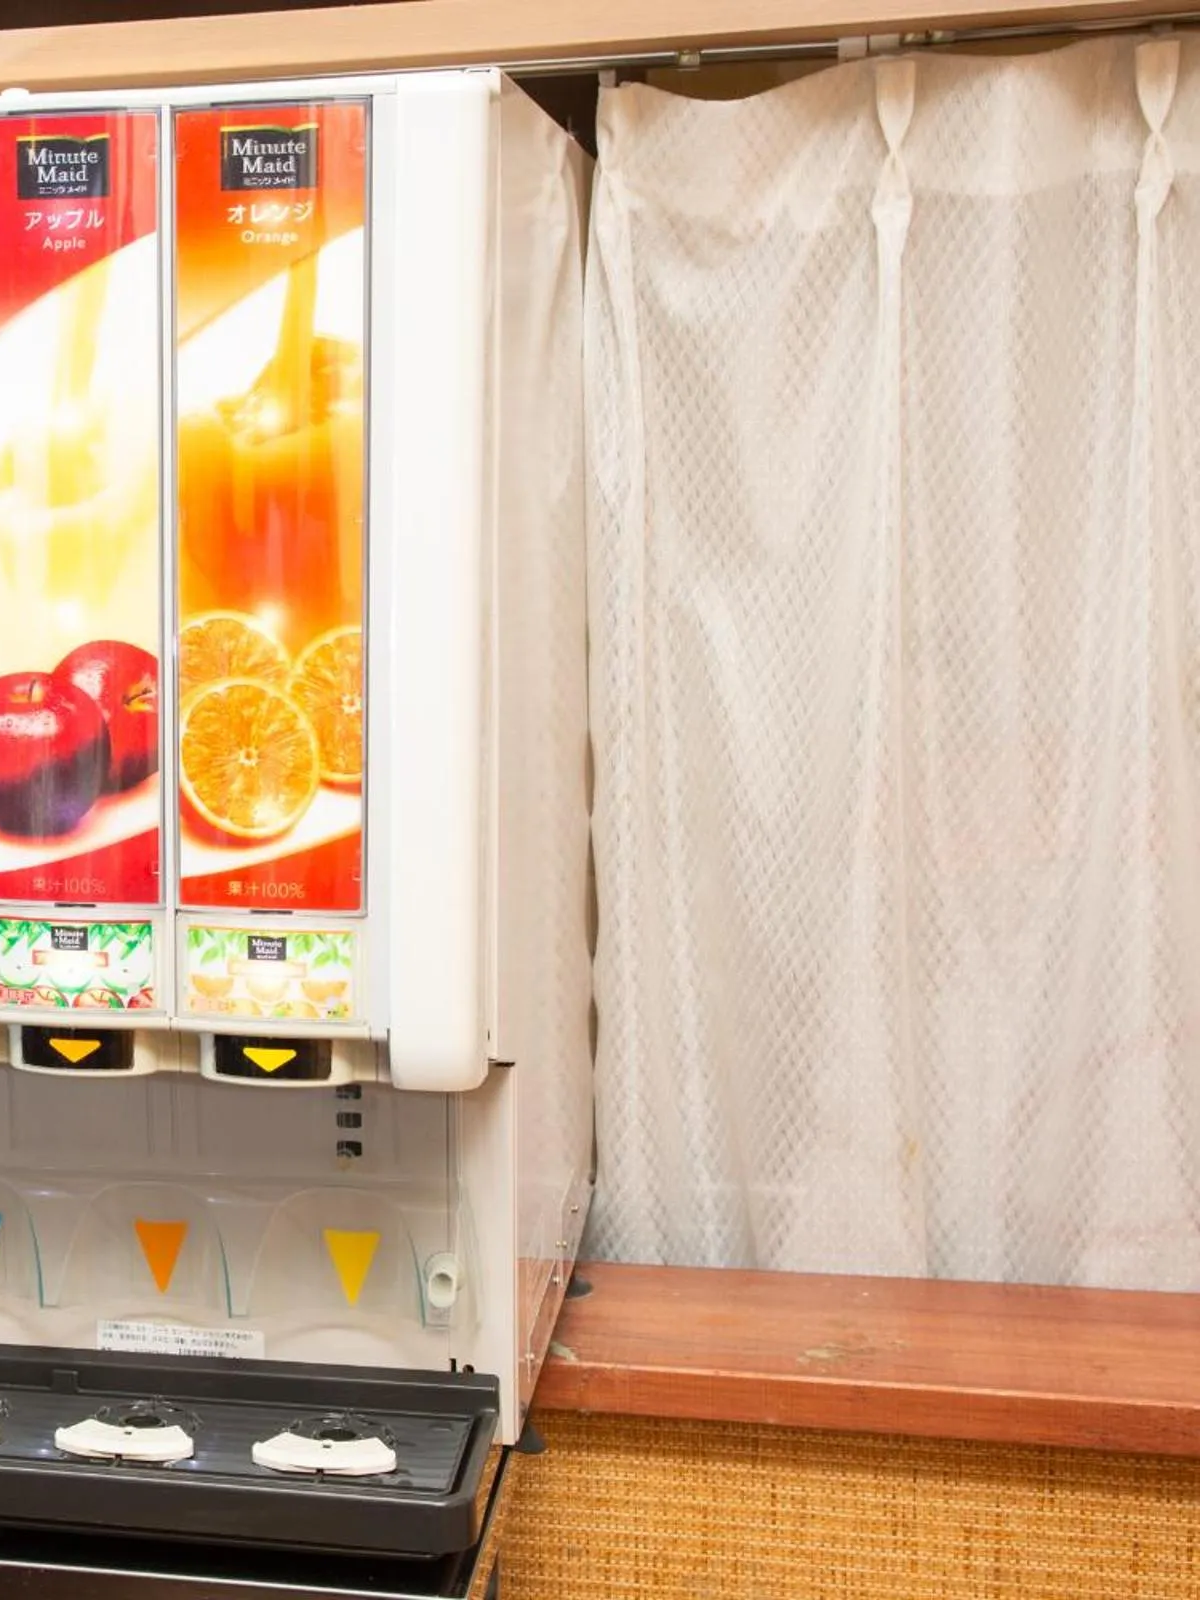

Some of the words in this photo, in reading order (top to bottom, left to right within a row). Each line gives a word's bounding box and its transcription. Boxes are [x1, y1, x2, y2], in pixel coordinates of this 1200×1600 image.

[27, 147, 98, 165] Minute
[232, 138, 306, 156] Minute
[243, 155, 296, 173] Maid
[37, 165, 89, 183] Maid
[25, 207, 105, 230] アップル
[227, 200, 313, 224] オレンジ
[43, 236, 86, 251] Apple
[241, 230, 299, 246] Orange
[225, 880, 306, 899] 果汁100%
